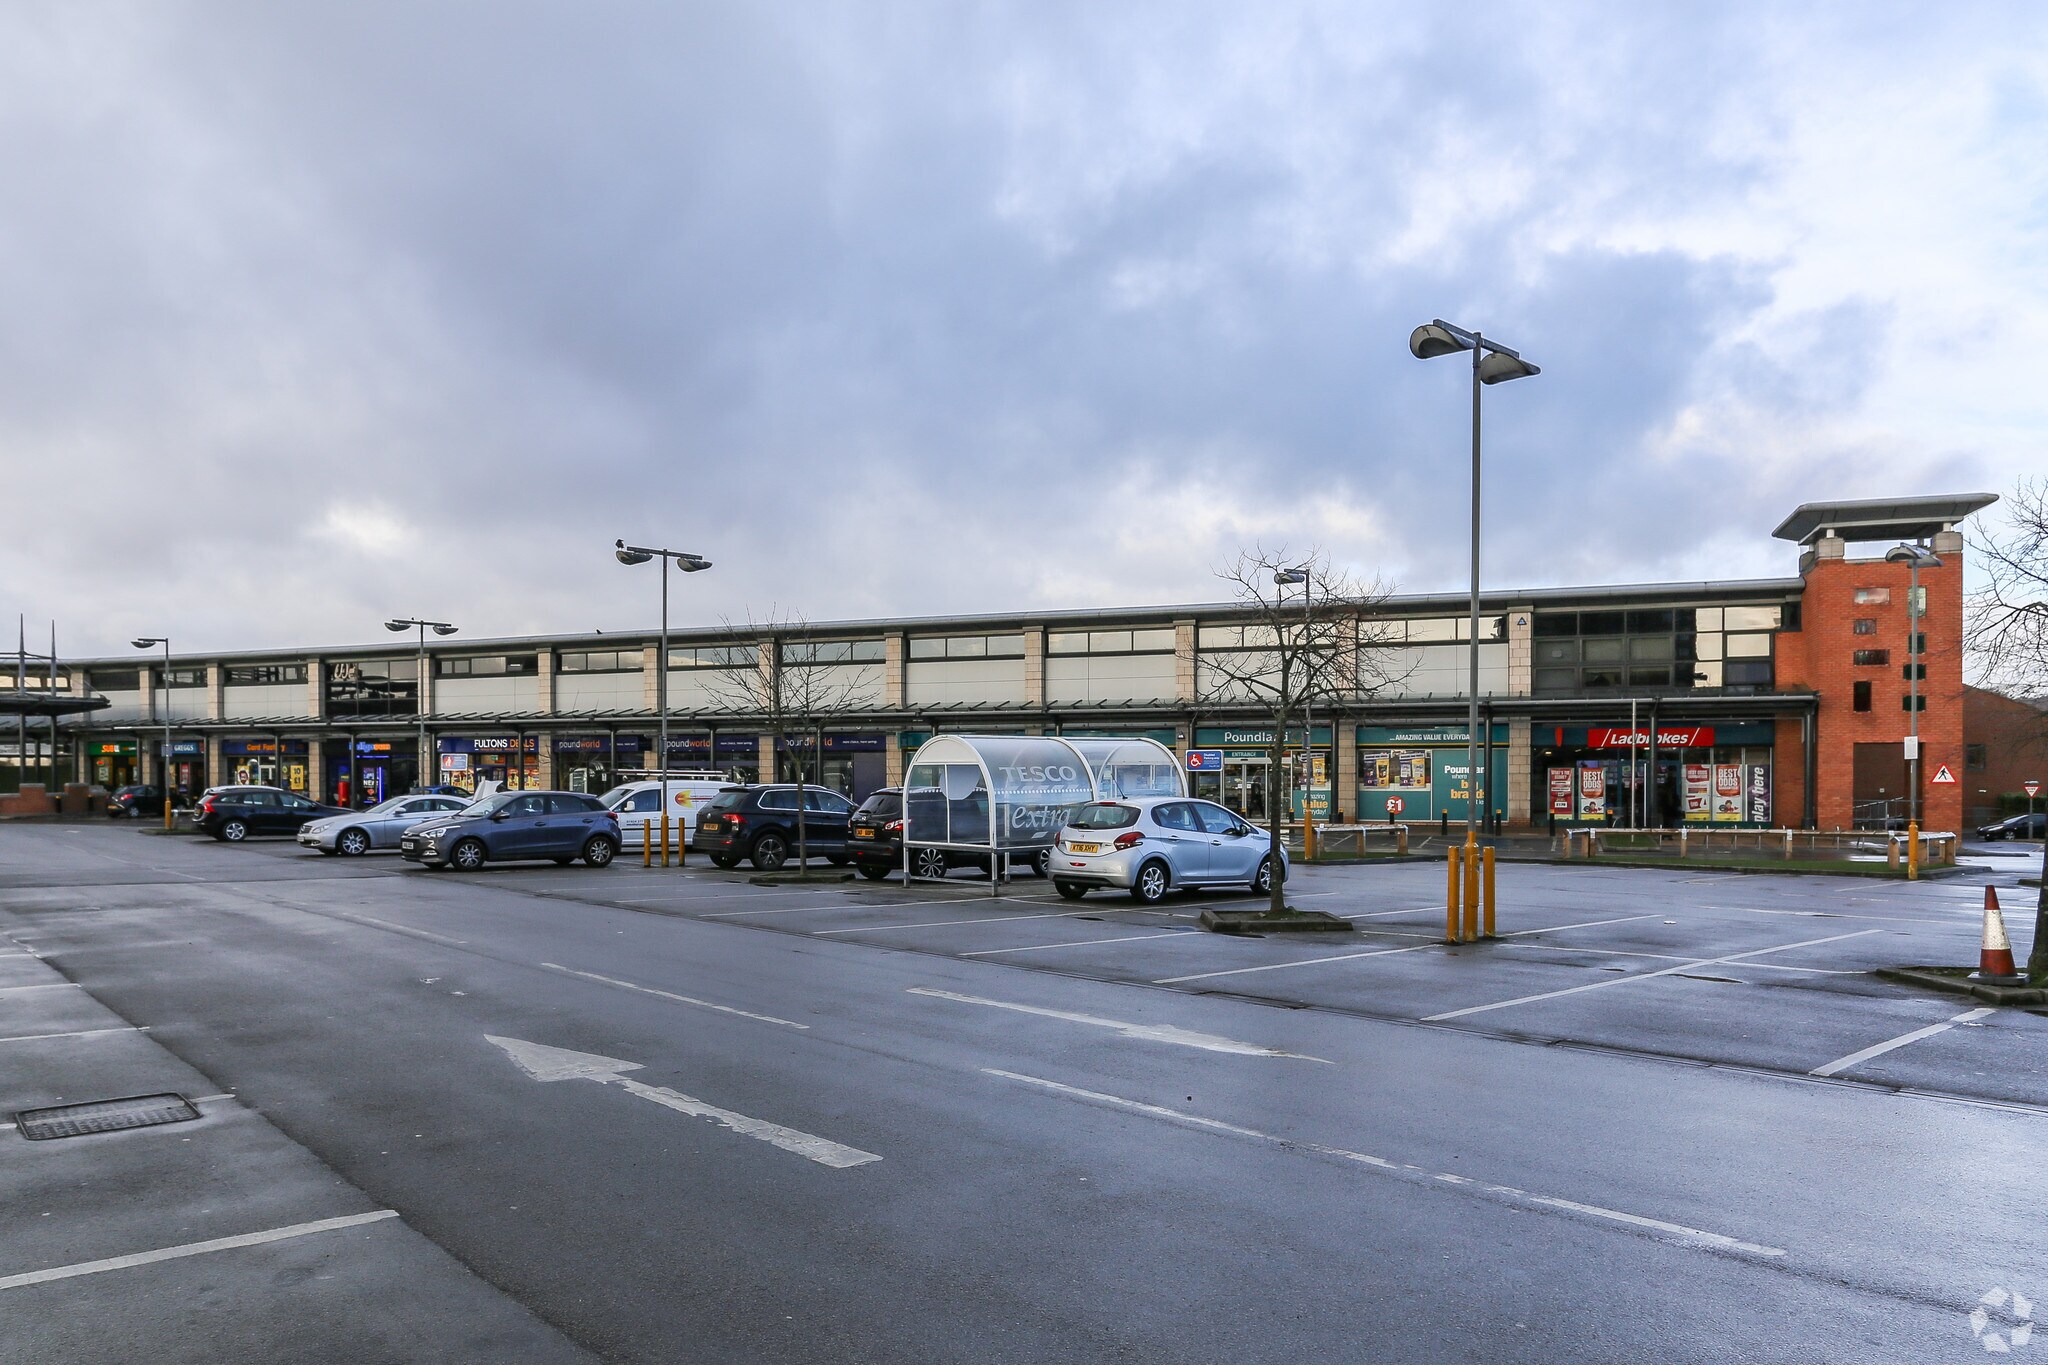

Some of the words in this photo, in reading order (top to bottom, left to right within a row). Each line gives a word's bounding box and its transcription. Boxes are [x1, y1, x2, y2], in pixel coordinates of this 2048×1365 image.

[474, 739, 508, 748] FULTONS
[509, 739, 535, 748] DELS
[998, 765, 1077, 782] TESCO
[1583, 771, 1602, 780] BEST
[1718, 768, 1738, 778] BEST
[1752, 767, 1764, 796] here
[1387, 799, 1402, 811] £1
[1012, 806, 1071, 829] extra
